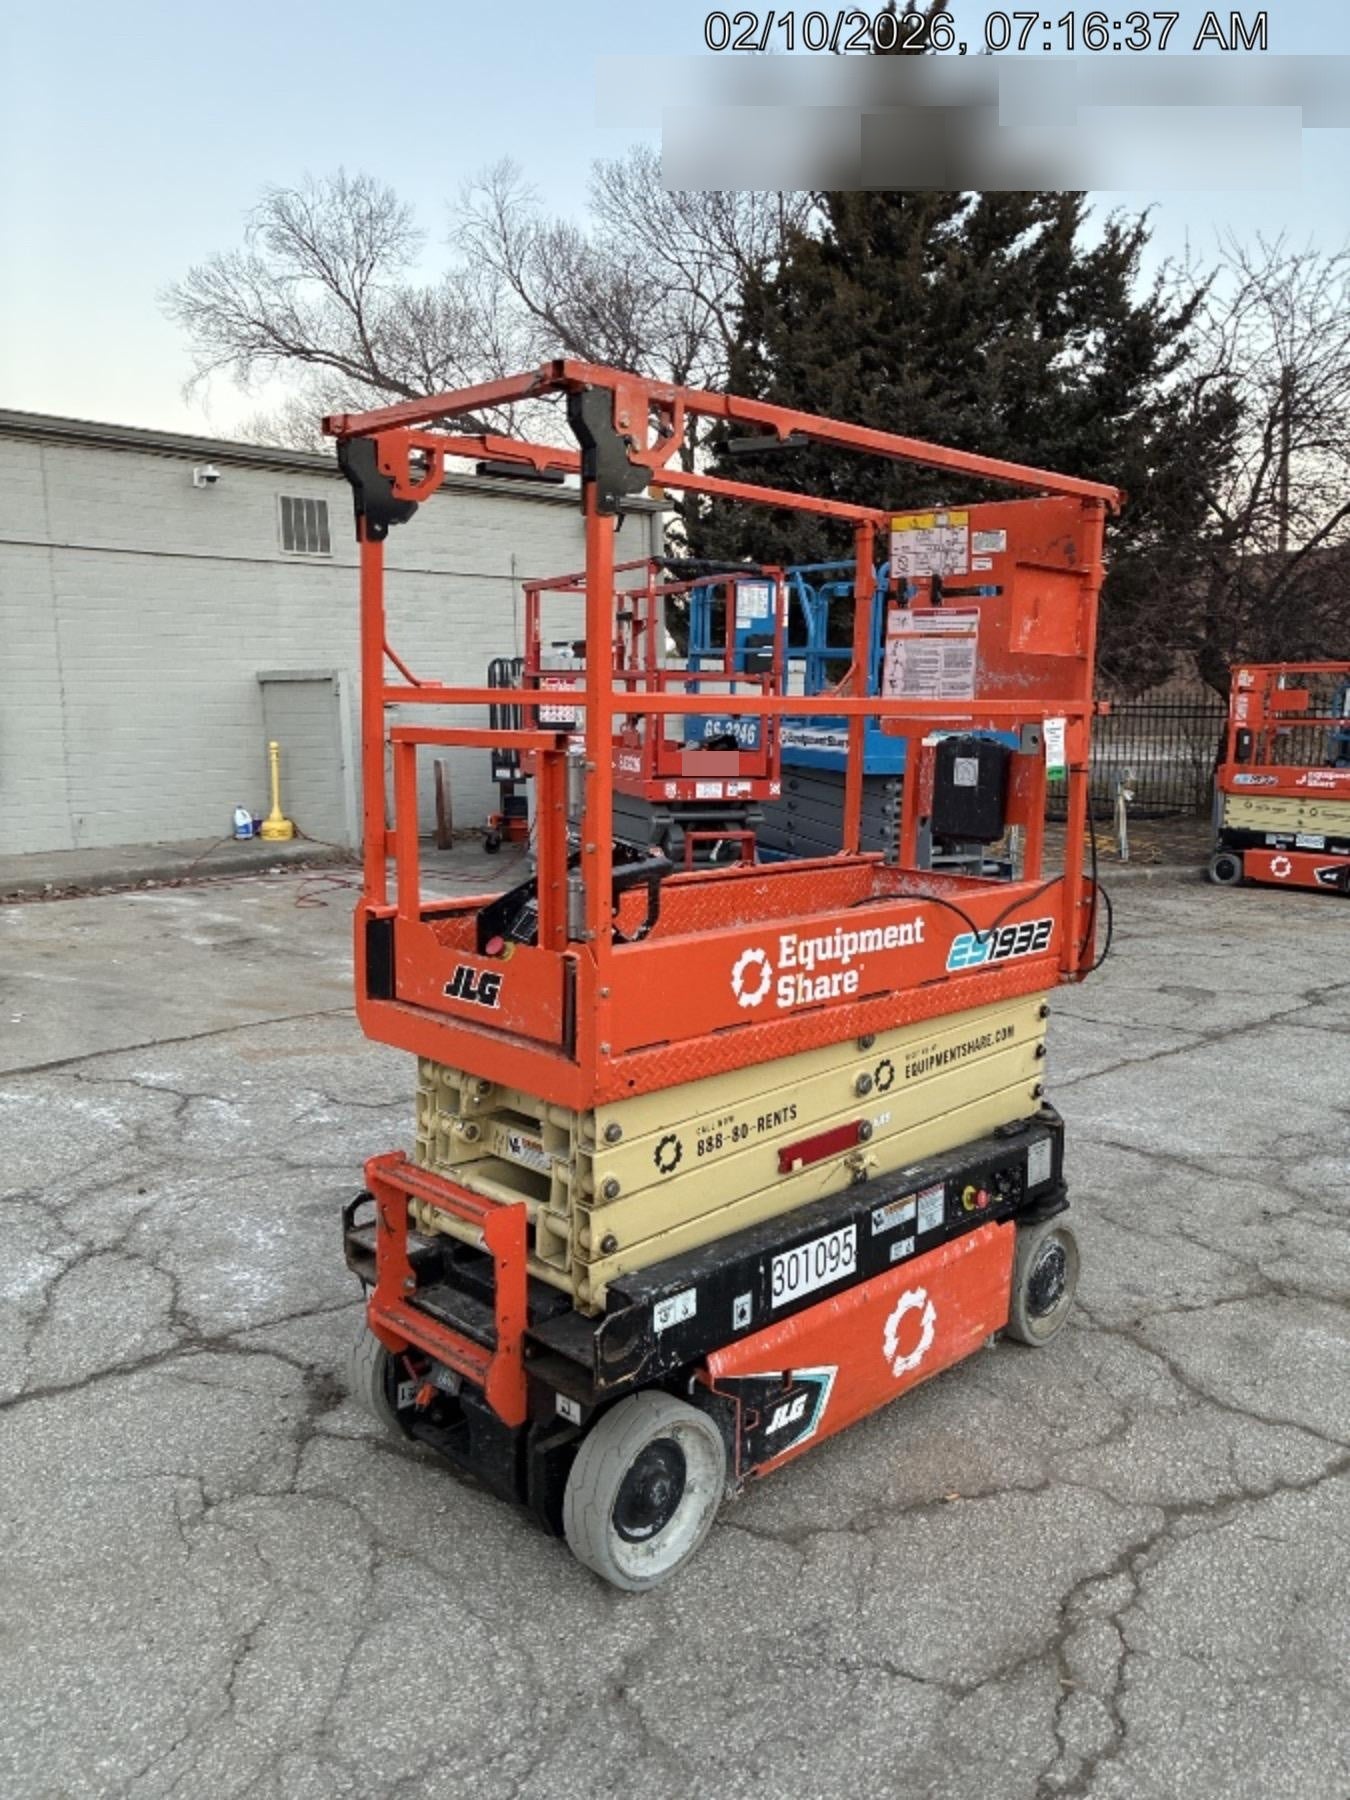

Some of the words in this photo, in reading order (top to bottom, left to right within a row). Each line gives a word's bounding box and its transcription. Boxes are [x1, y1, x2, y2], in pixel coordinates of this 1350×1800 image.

[778, 916, 925, 970] Equipment
[948, 918, 1054, 971] ES1932
[444, 964, 503, 1009] JLG
[776, 968, 860, 1009] Share
[904, 1024, 1016, 1080] EQUIPMENTSHARE.COM
[697, 1104, 798, 1157] 888-80-RENTS
[773, 1229, 853, 1297] 301095
[765, 1393, 809, 1436] JLG
